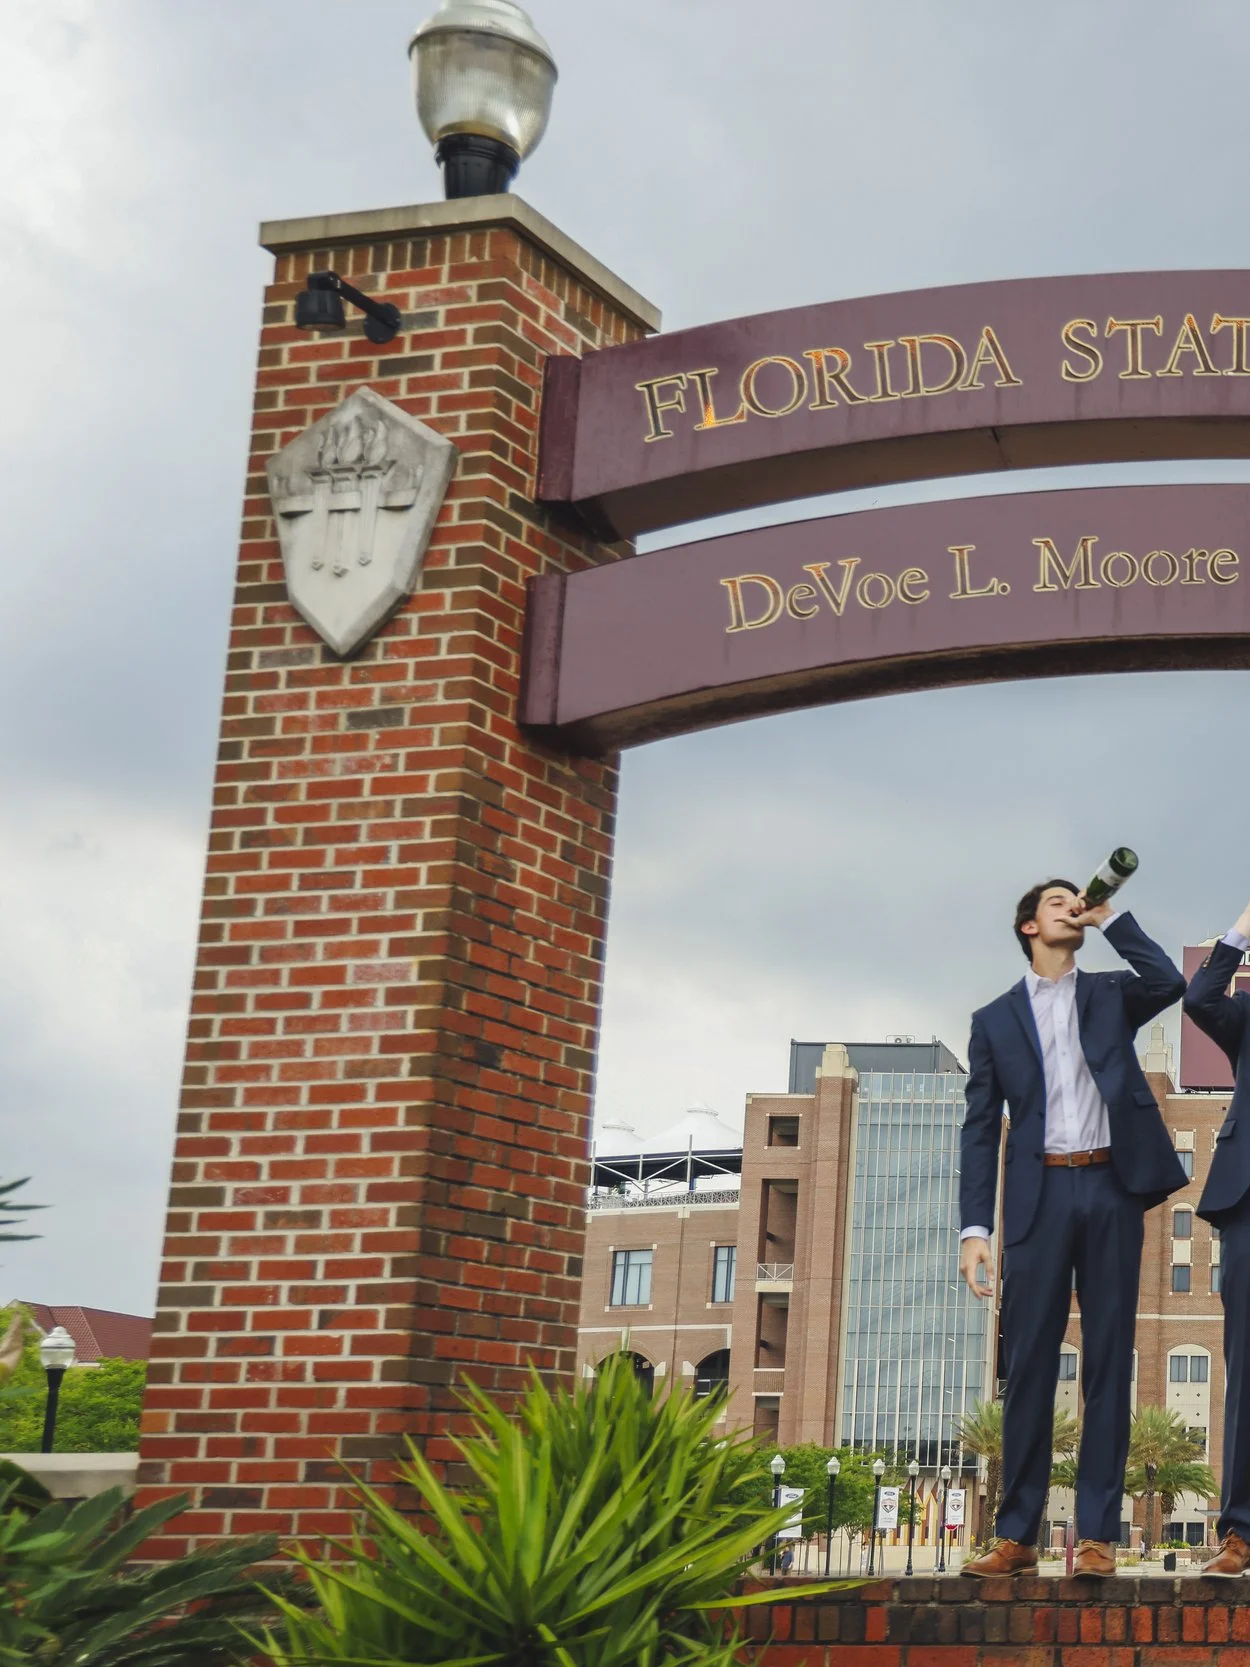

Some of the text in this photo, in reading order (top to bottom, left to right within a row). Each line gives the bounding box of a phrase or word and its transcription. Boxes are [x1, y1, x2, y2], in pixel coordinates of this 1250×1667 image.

[635, 326, 1023, 443] FLORIDA
[720, 558, 930, 633] DeVoe
[948, 544, 1011, 599] L.
[1032, 535, 1240, 593] Moore
